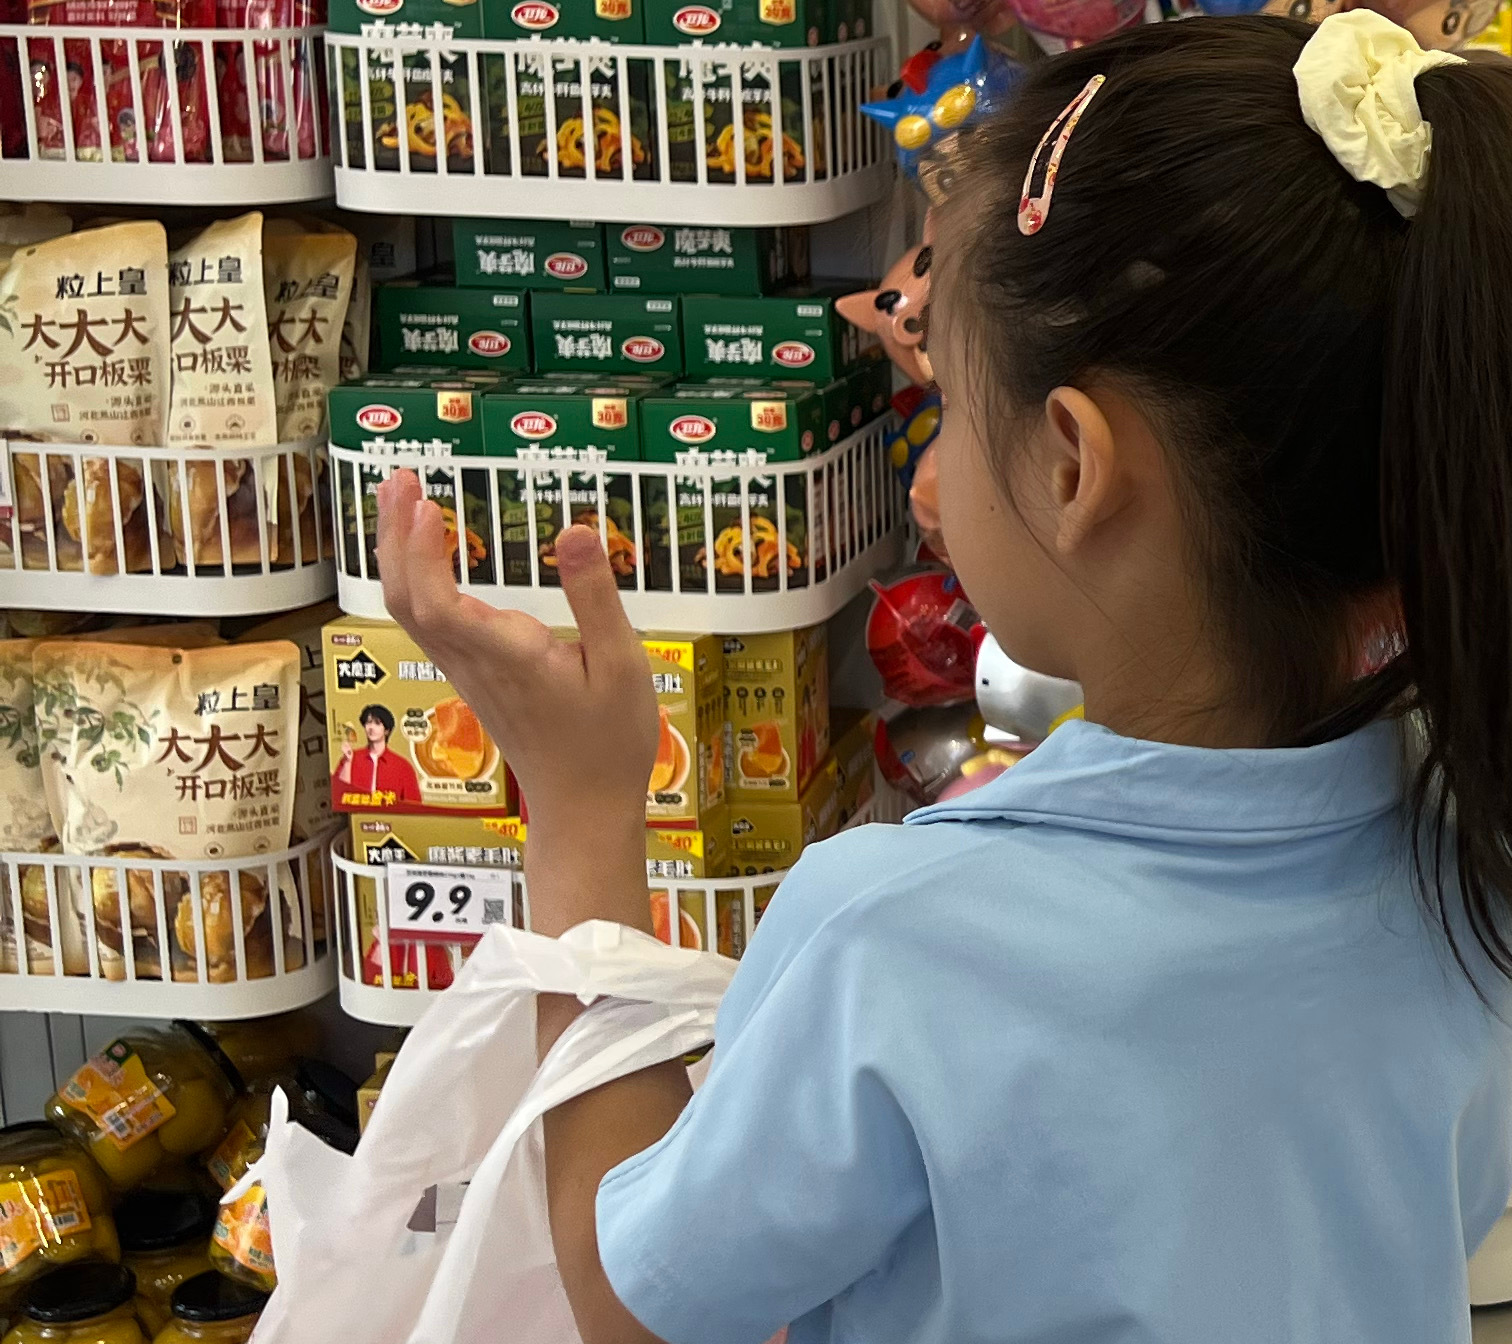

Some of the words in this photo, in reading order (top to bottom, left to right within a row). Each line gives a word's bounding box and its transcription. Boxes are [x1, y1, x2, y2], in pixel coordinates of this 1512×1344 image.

[55, 266, 147, 300] 粒上皇
[170, 255, 243, 286] 粒上皇
[21, 307, 150, 359] 大大大
[44, 358, 153, 390] 开口板栗
[194, 682, 280, 716] 粒上皇
[156, 723, 280, 773] 大大大
[174, 770, 281, 803] 开口板栗
[406, 882, 472, 922] 9.9
